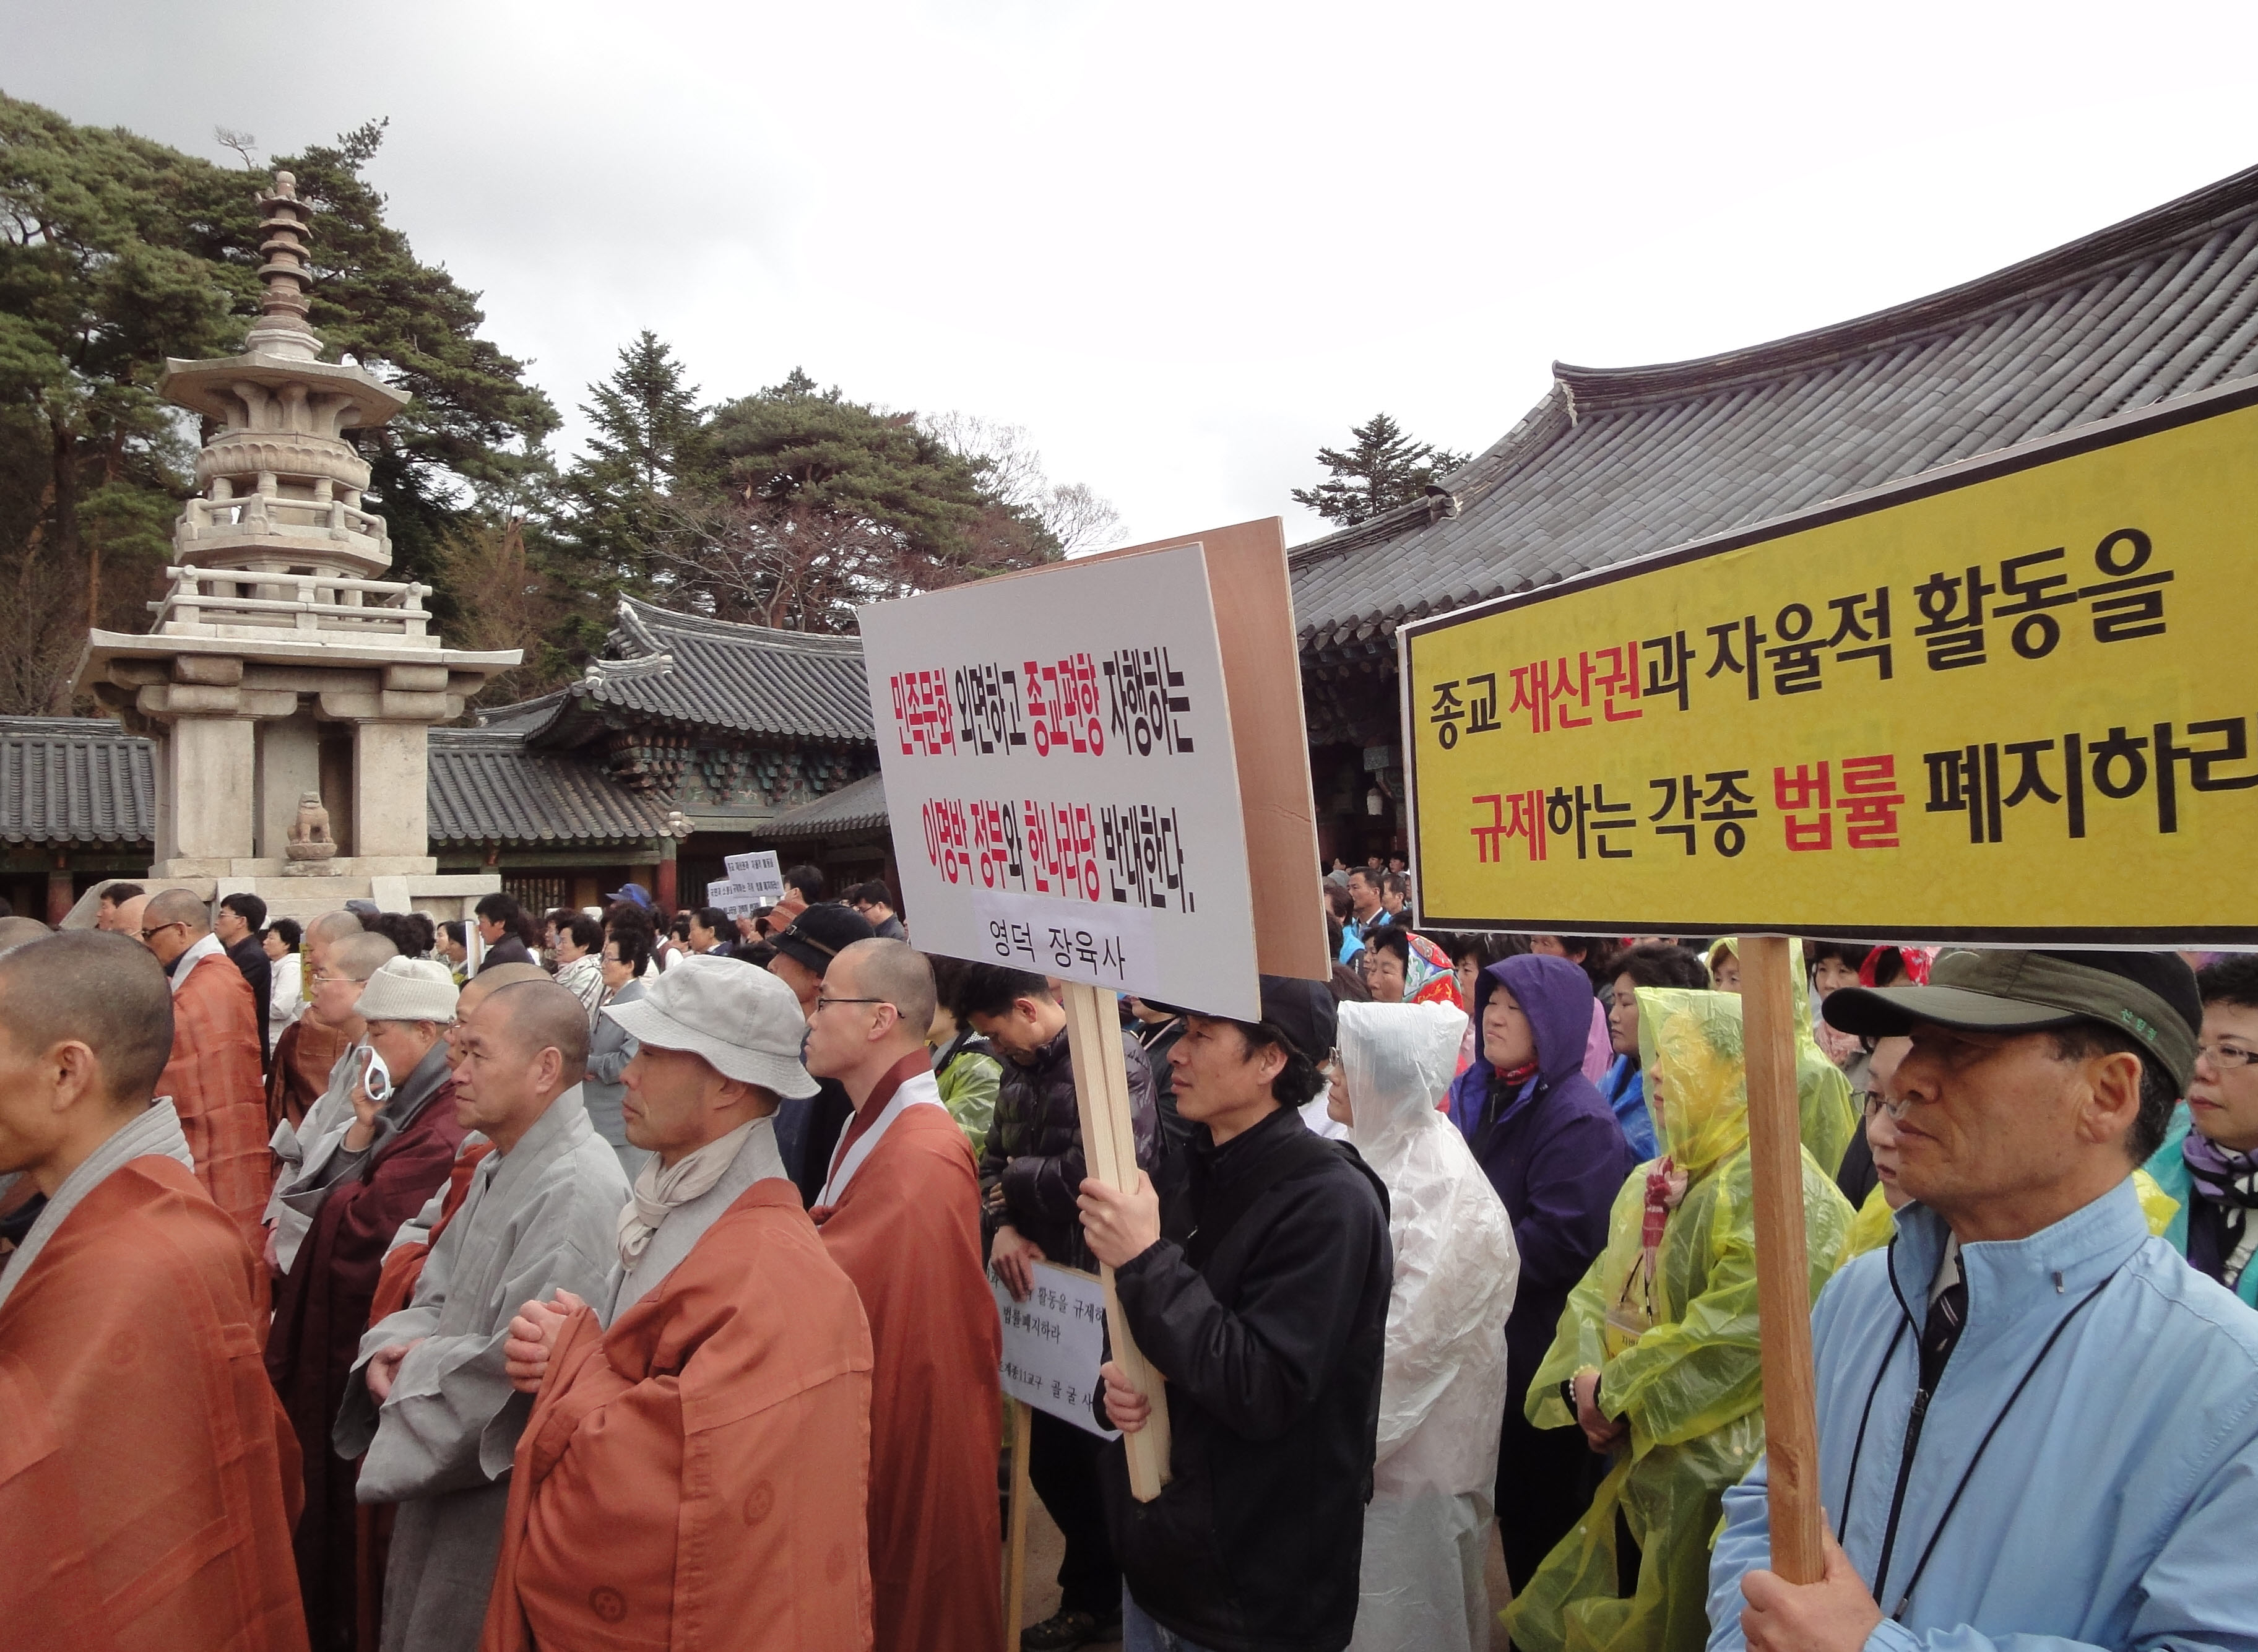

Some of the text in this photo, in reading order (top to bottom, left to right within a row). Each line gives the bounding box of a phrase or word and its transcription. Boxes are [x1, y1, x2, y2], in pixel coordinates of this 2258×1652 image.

[1430, 528, 2174, 750] 종교 재산권과 자율적 활동을
[890, 646, 1195, 757] 민족문화 외면하고 종교편향 자행하는
[922, 798, 1195, 914] 이명박 정부와 한나라당 반대한다.
[1471, 784, 1637, 863] 규제하는
[1648, 769, 1757, 858] 각종
[1774, 754, 1905, 852] 법률
[990, 919, 1127, 980] 영덕 장육사
[1038, 1287, 1068, 1314] 활동을
